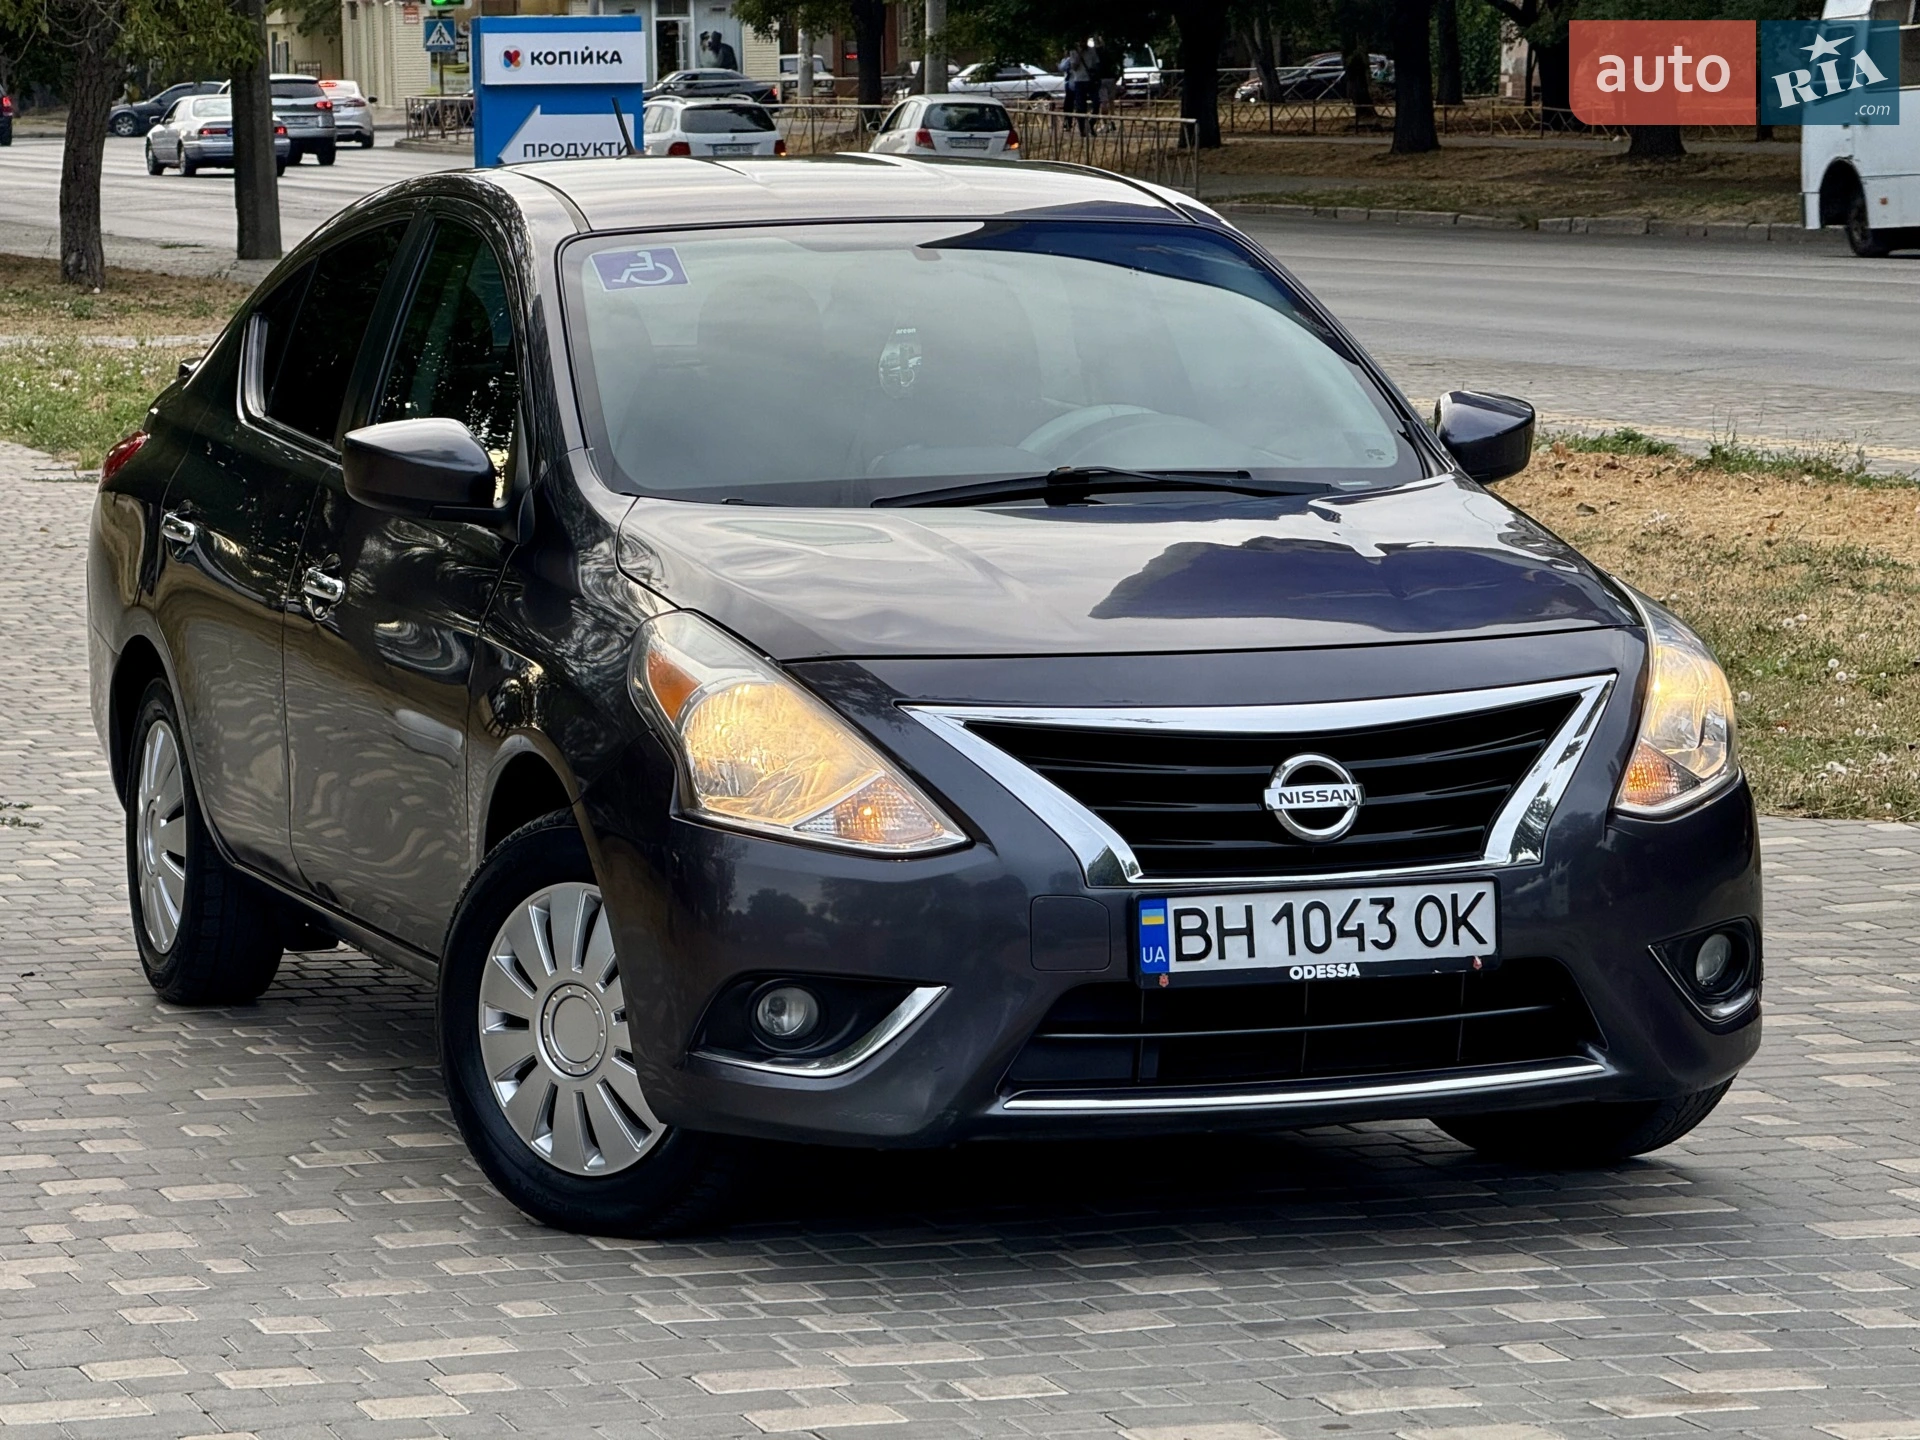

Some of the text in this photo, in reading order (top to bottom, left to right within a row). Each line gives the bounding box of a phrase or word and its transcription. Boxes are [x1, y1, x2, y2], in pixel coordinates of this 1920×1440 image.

[530, 46, 622, 66] КОПІЙКА
[1278, 788, 1357, 805] NISSAN
[1173, 891, 1488, 962] BH 1043 OK
[1142, 946, 1167, 963] UA
[1289, 962, 1361, 980] ODESSA
